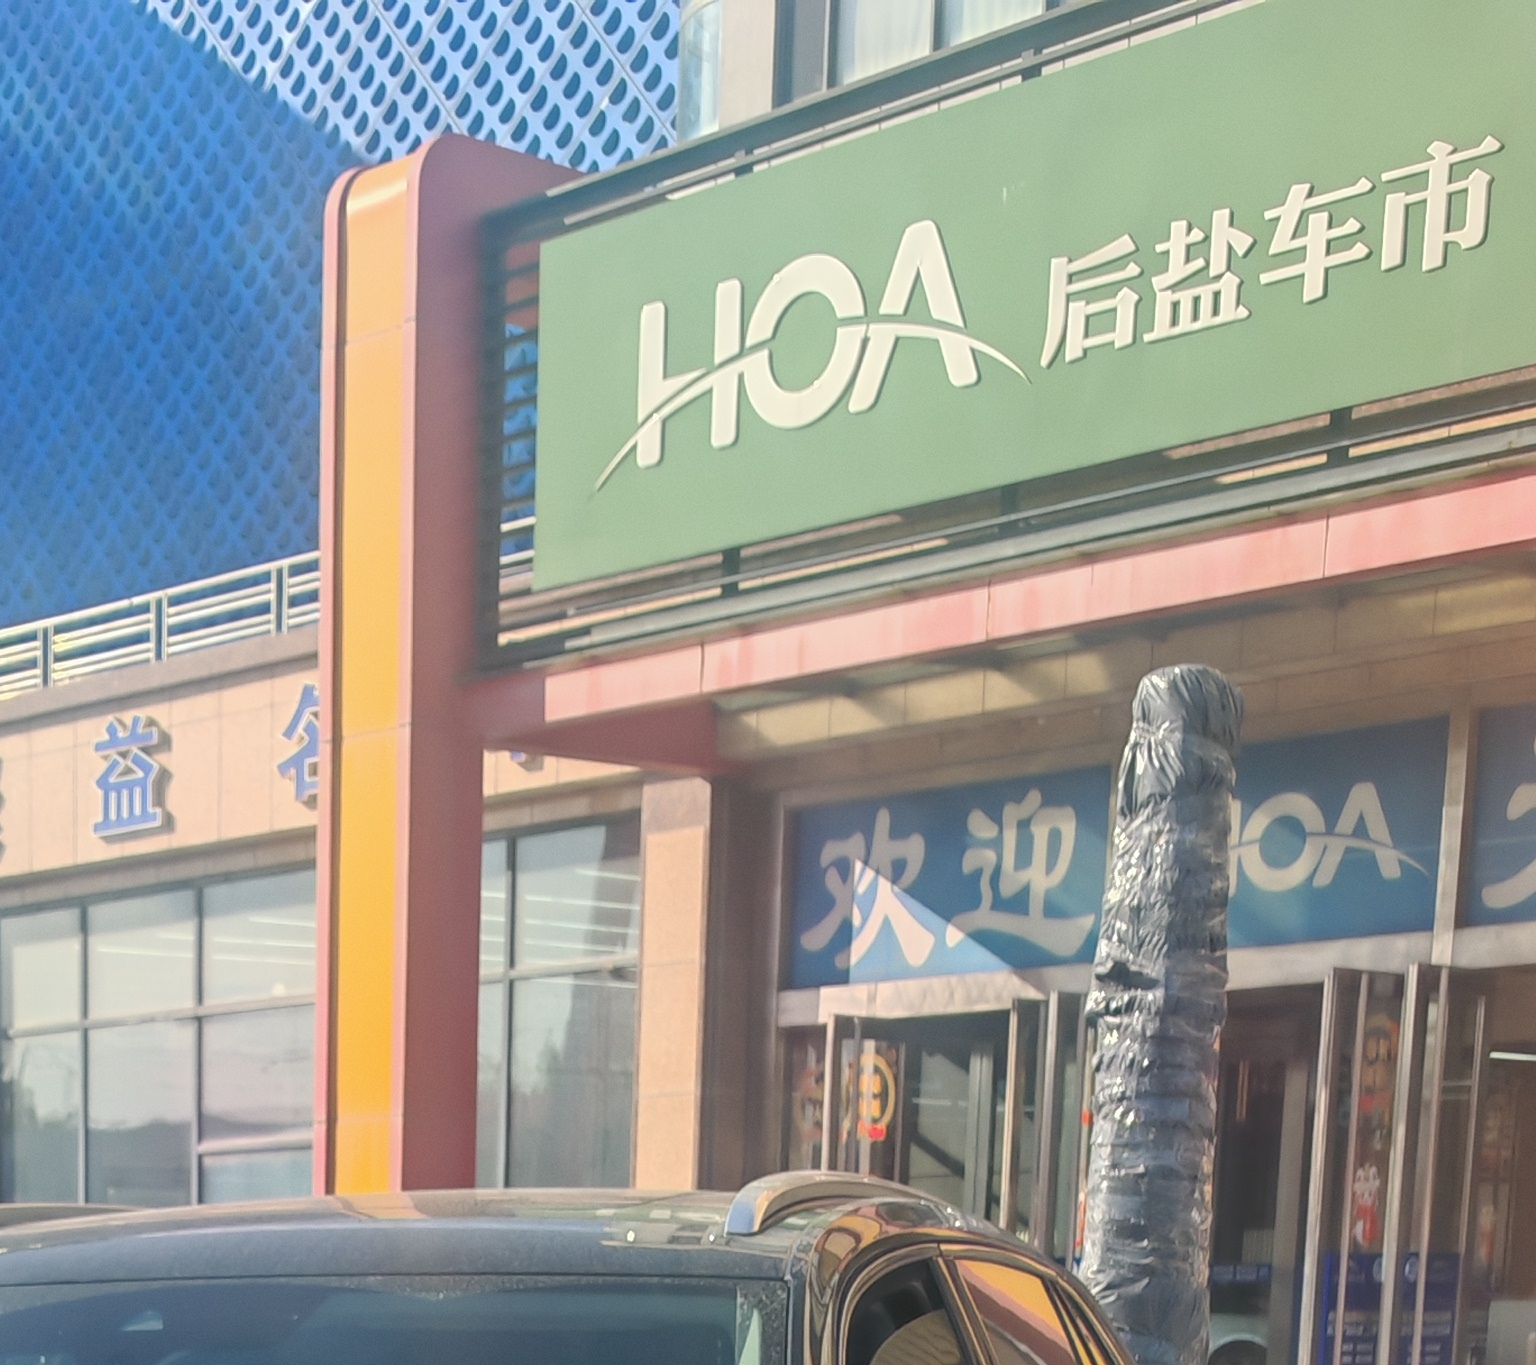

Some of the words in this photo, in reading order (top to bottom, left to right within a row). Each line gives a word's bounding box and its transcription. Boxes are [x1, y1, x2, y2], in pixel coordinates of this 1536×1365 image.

[632, 220, 982, 471] HOA
[1040, 134, 1504, 370] 后盐车市
[800, 788, 1096, 968] 欢迎
[1228, 781, 1402, 898] OA
